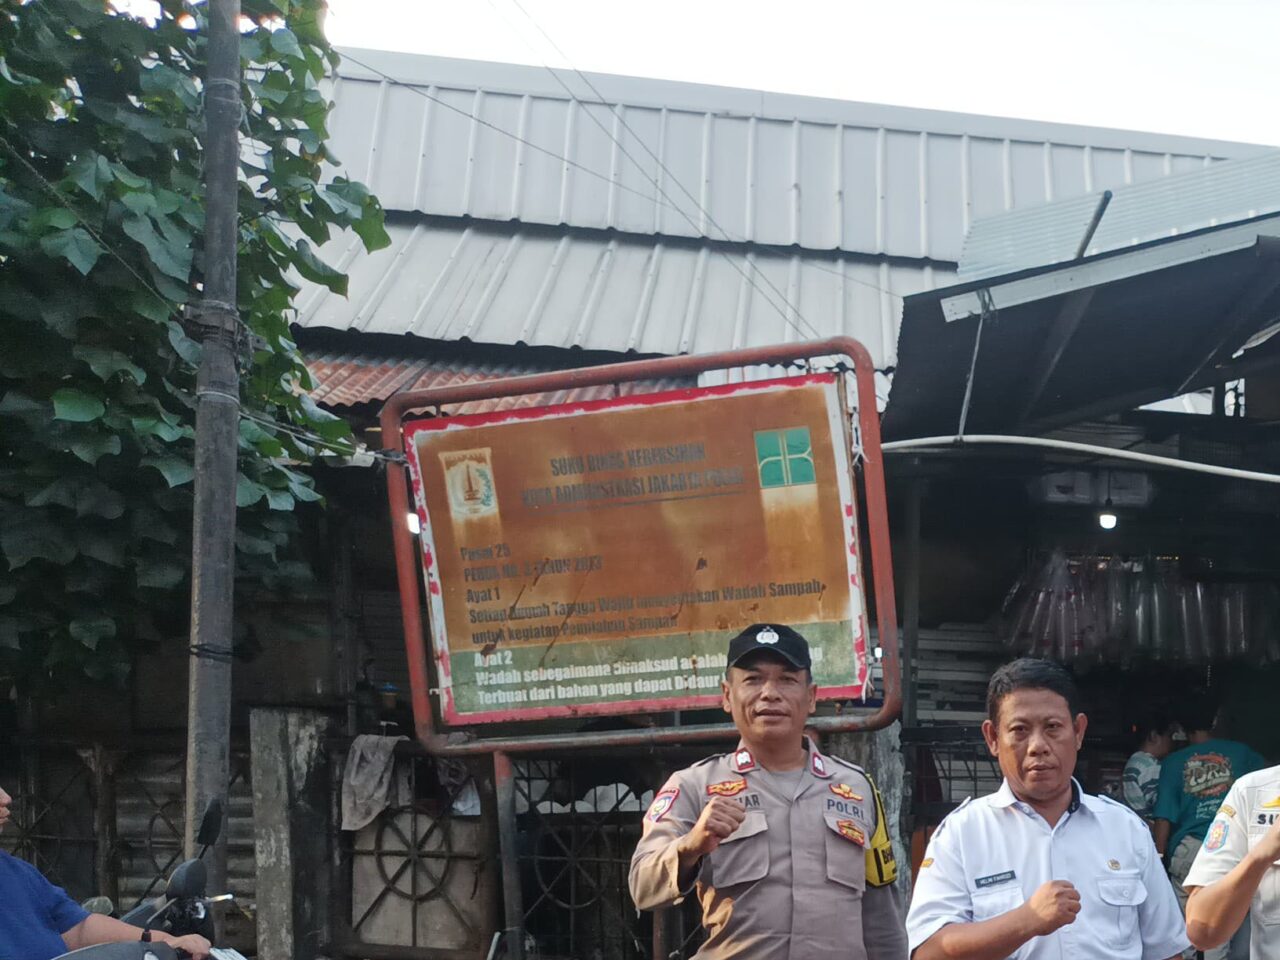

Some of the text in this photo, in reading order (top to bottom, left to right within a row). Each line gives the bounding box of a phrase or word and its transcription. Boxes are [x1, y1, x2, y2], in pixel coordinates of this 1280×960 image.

[551, 457, 583, 475] SUKU
[466, 587, 500, 603] Ayat 1
[768, 579, 821, 598] Sampah
[508, 623, 560, 641] kegiatan
[504, 650, 513, 664] 2
[476, 669, 522, 685] Wadah
[479, 688, 528, 704] Terbuat
[529, 686, 556, 700] dari
[557, 683, 598, 698] bahan
[600, 682, 633, 697] yang
[633, 677, 672, 693] dapat
[827, 797, 865, 821] POLRI
